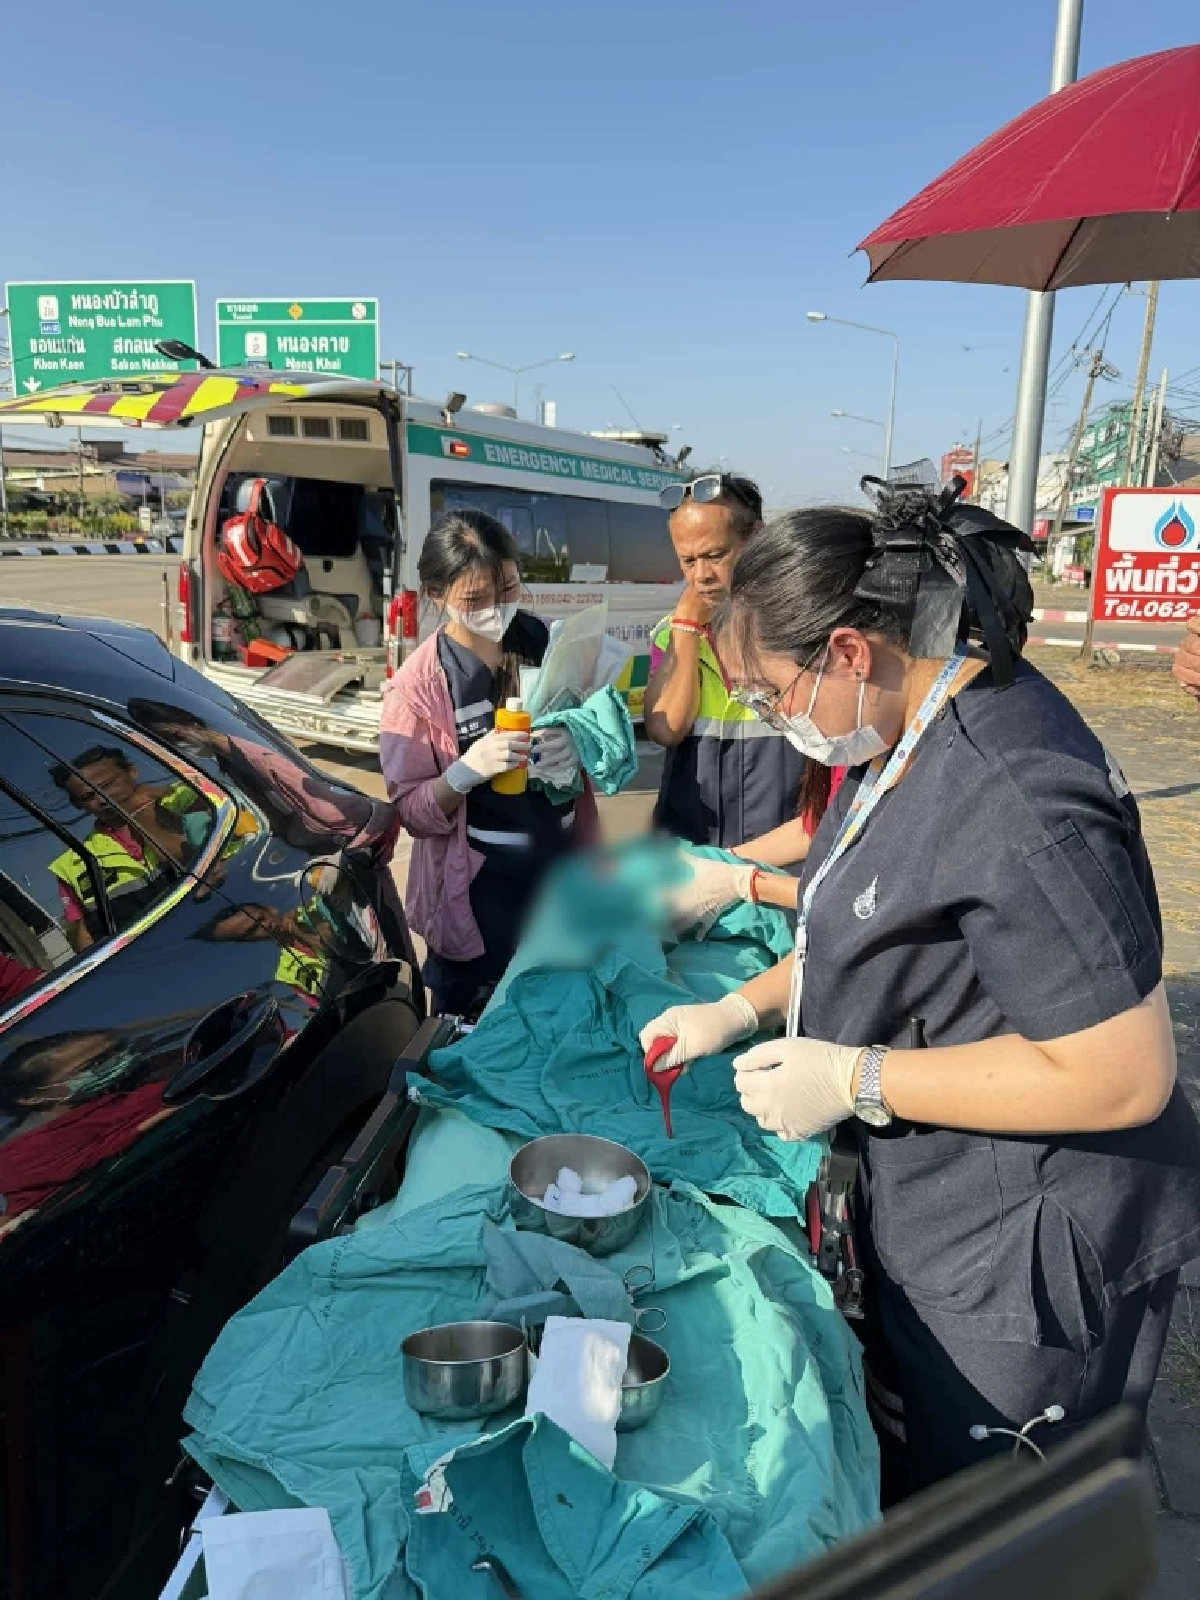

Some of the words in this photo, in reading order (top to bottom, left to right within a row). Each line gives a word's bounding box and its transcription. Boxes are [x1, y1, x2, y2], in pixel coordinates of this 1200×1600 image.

[71, 289, 159, 315] หนองบัวลำภู
[68, 316, 95, 329] Nong
[97, 316, 116, 327] Bua
[118, 316, 141, 327] Lam
[143, 316, 163, 327] Phu
[29, 334, 86, 353] ขอนแก่น
[277, 336, 349, 354] หนองคาย
[33, 358, 58, 370] Khon
[60, 358, 85, 370] Kaen
[111, 358, 141, 370] Sakon
[286, 358, 312, 372] Nong
[316, 358, 342, 370] Khai
[484, 444, 578, 475] EMERGENCY
[580, 460, 637, 484] MEDICAL
